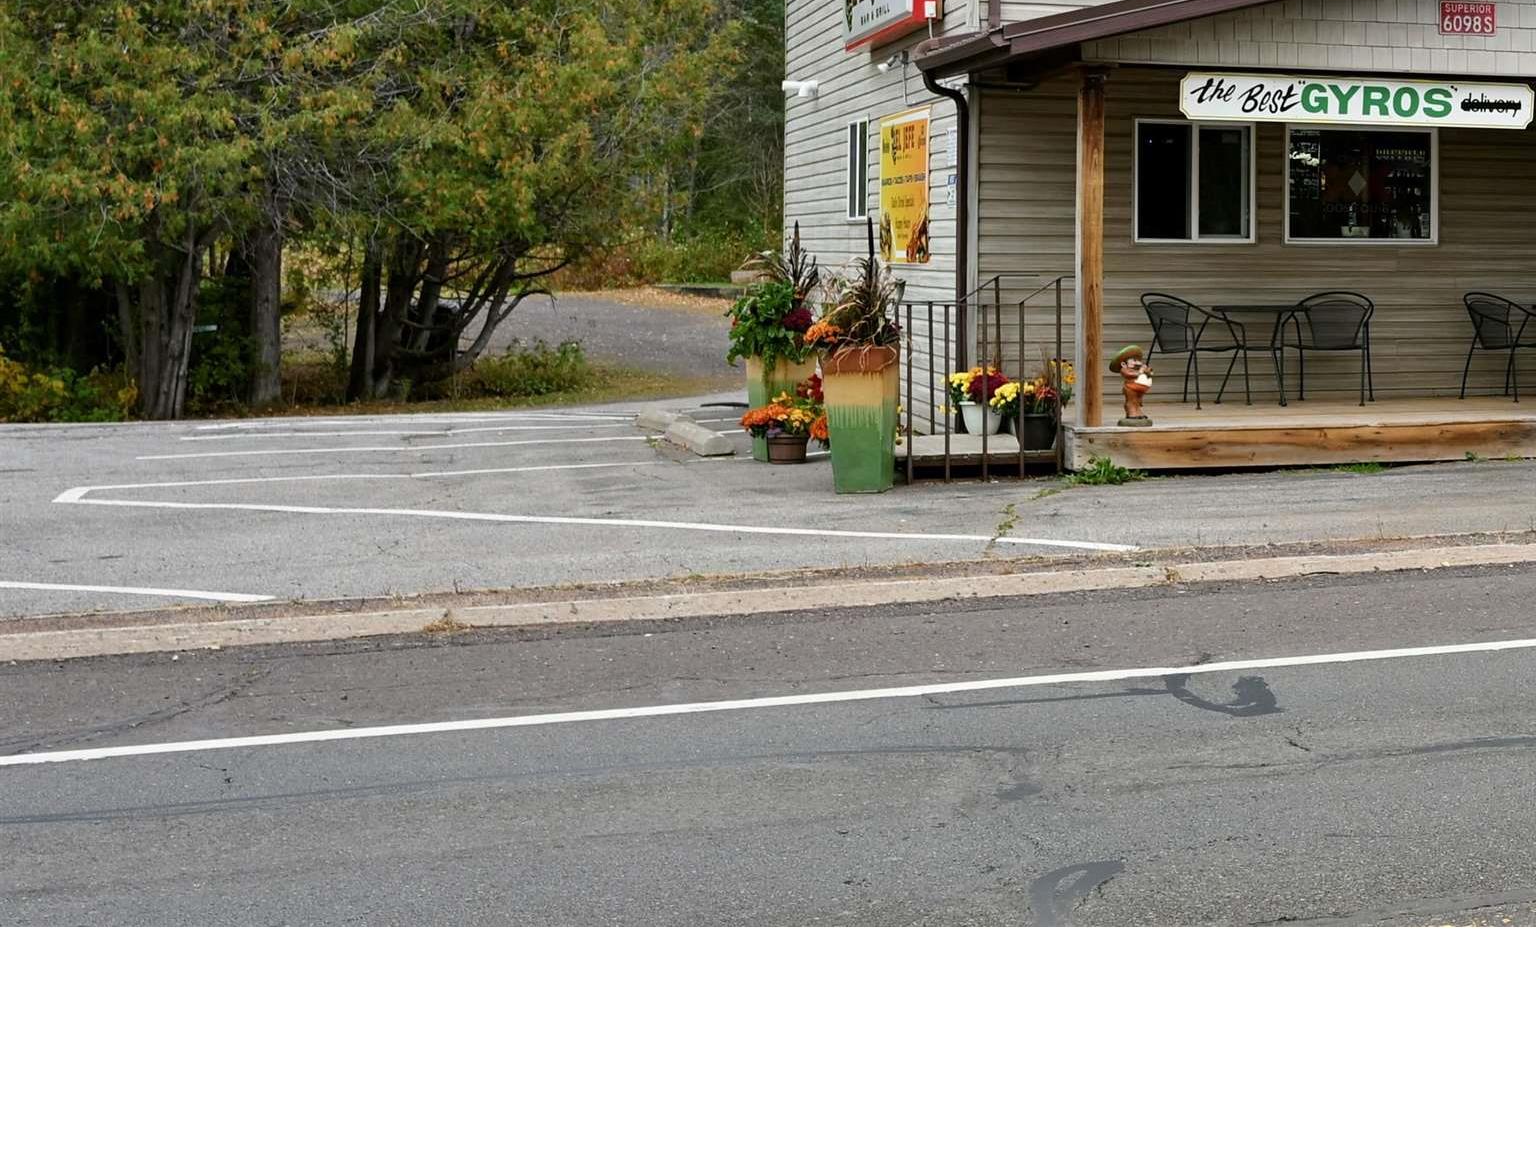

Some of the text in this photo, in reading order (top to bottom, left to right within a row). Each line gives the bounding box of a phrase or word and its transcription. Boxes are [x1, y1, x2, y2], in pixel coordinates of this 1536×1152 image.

[1444, 3, 1492, 14] SUPERIOR
[1190, 78, 1236, 104] the
[1239, 84, 1300, 114] Best
